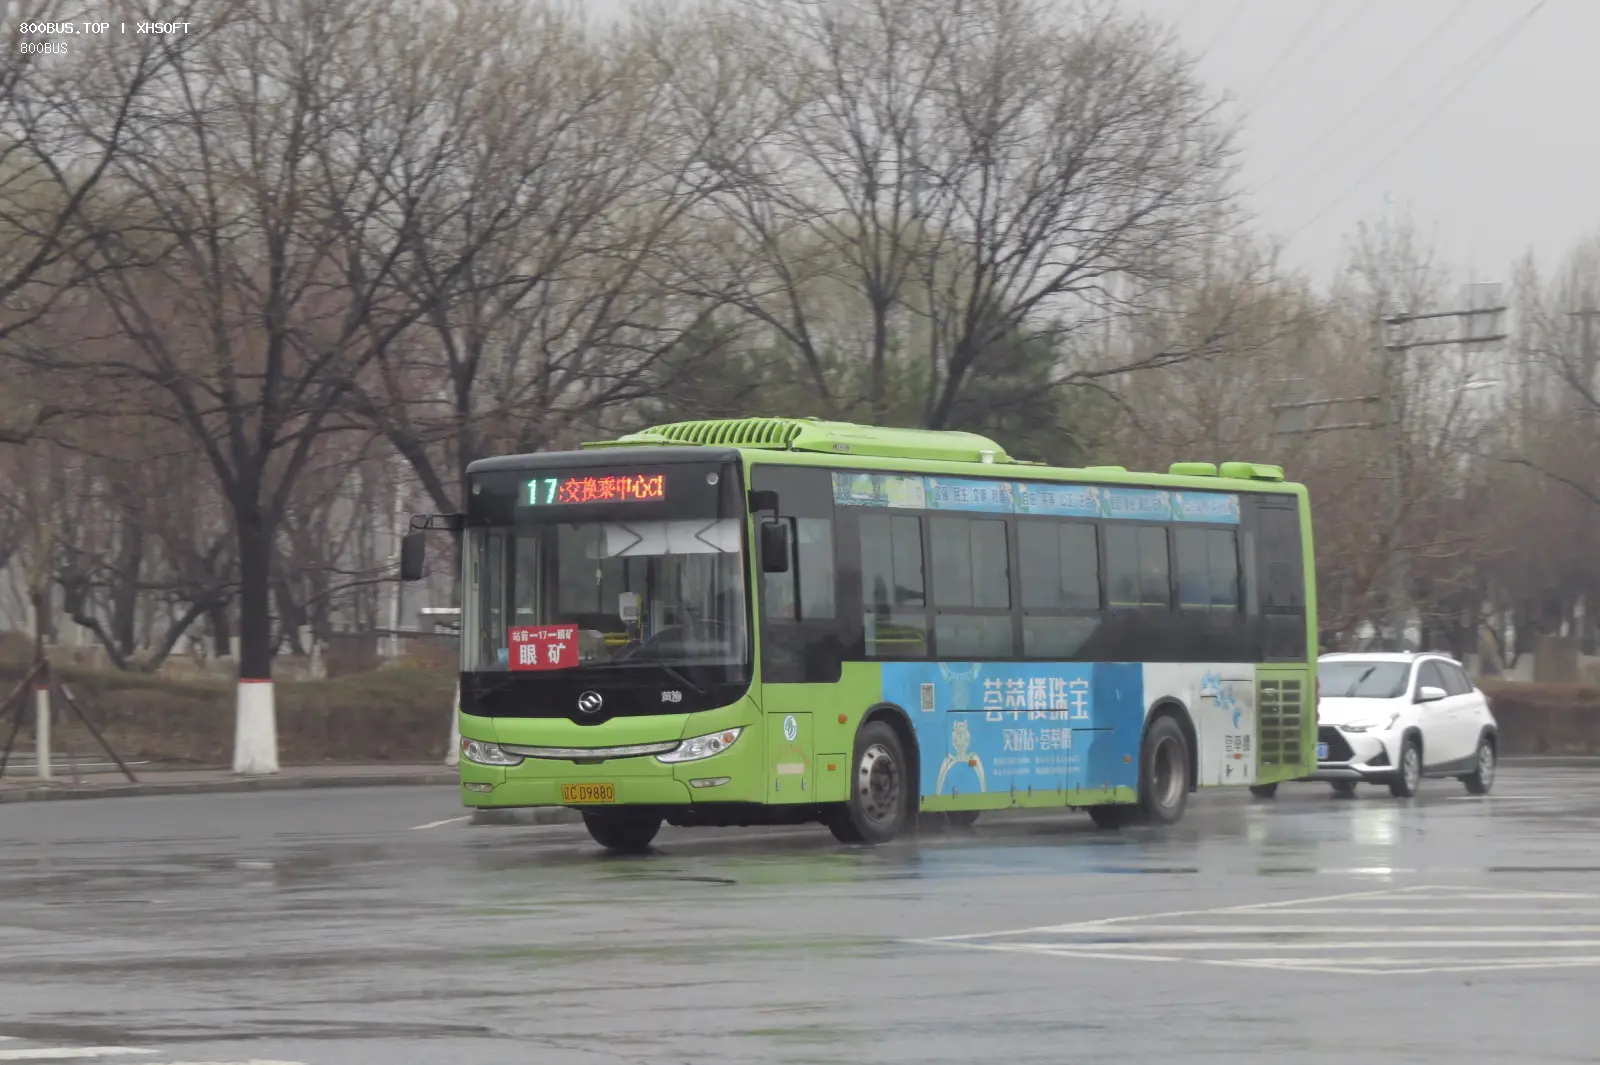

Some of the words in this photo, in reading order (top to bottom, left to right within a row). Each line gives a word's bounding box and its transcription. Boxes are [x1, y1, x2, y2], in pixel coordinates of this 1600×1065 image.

[527, 478, 558, 505] 17
[519, 642, 567, 665] 眼矿
[983, 677, 1090, 722] 荟萃楼珠宝
